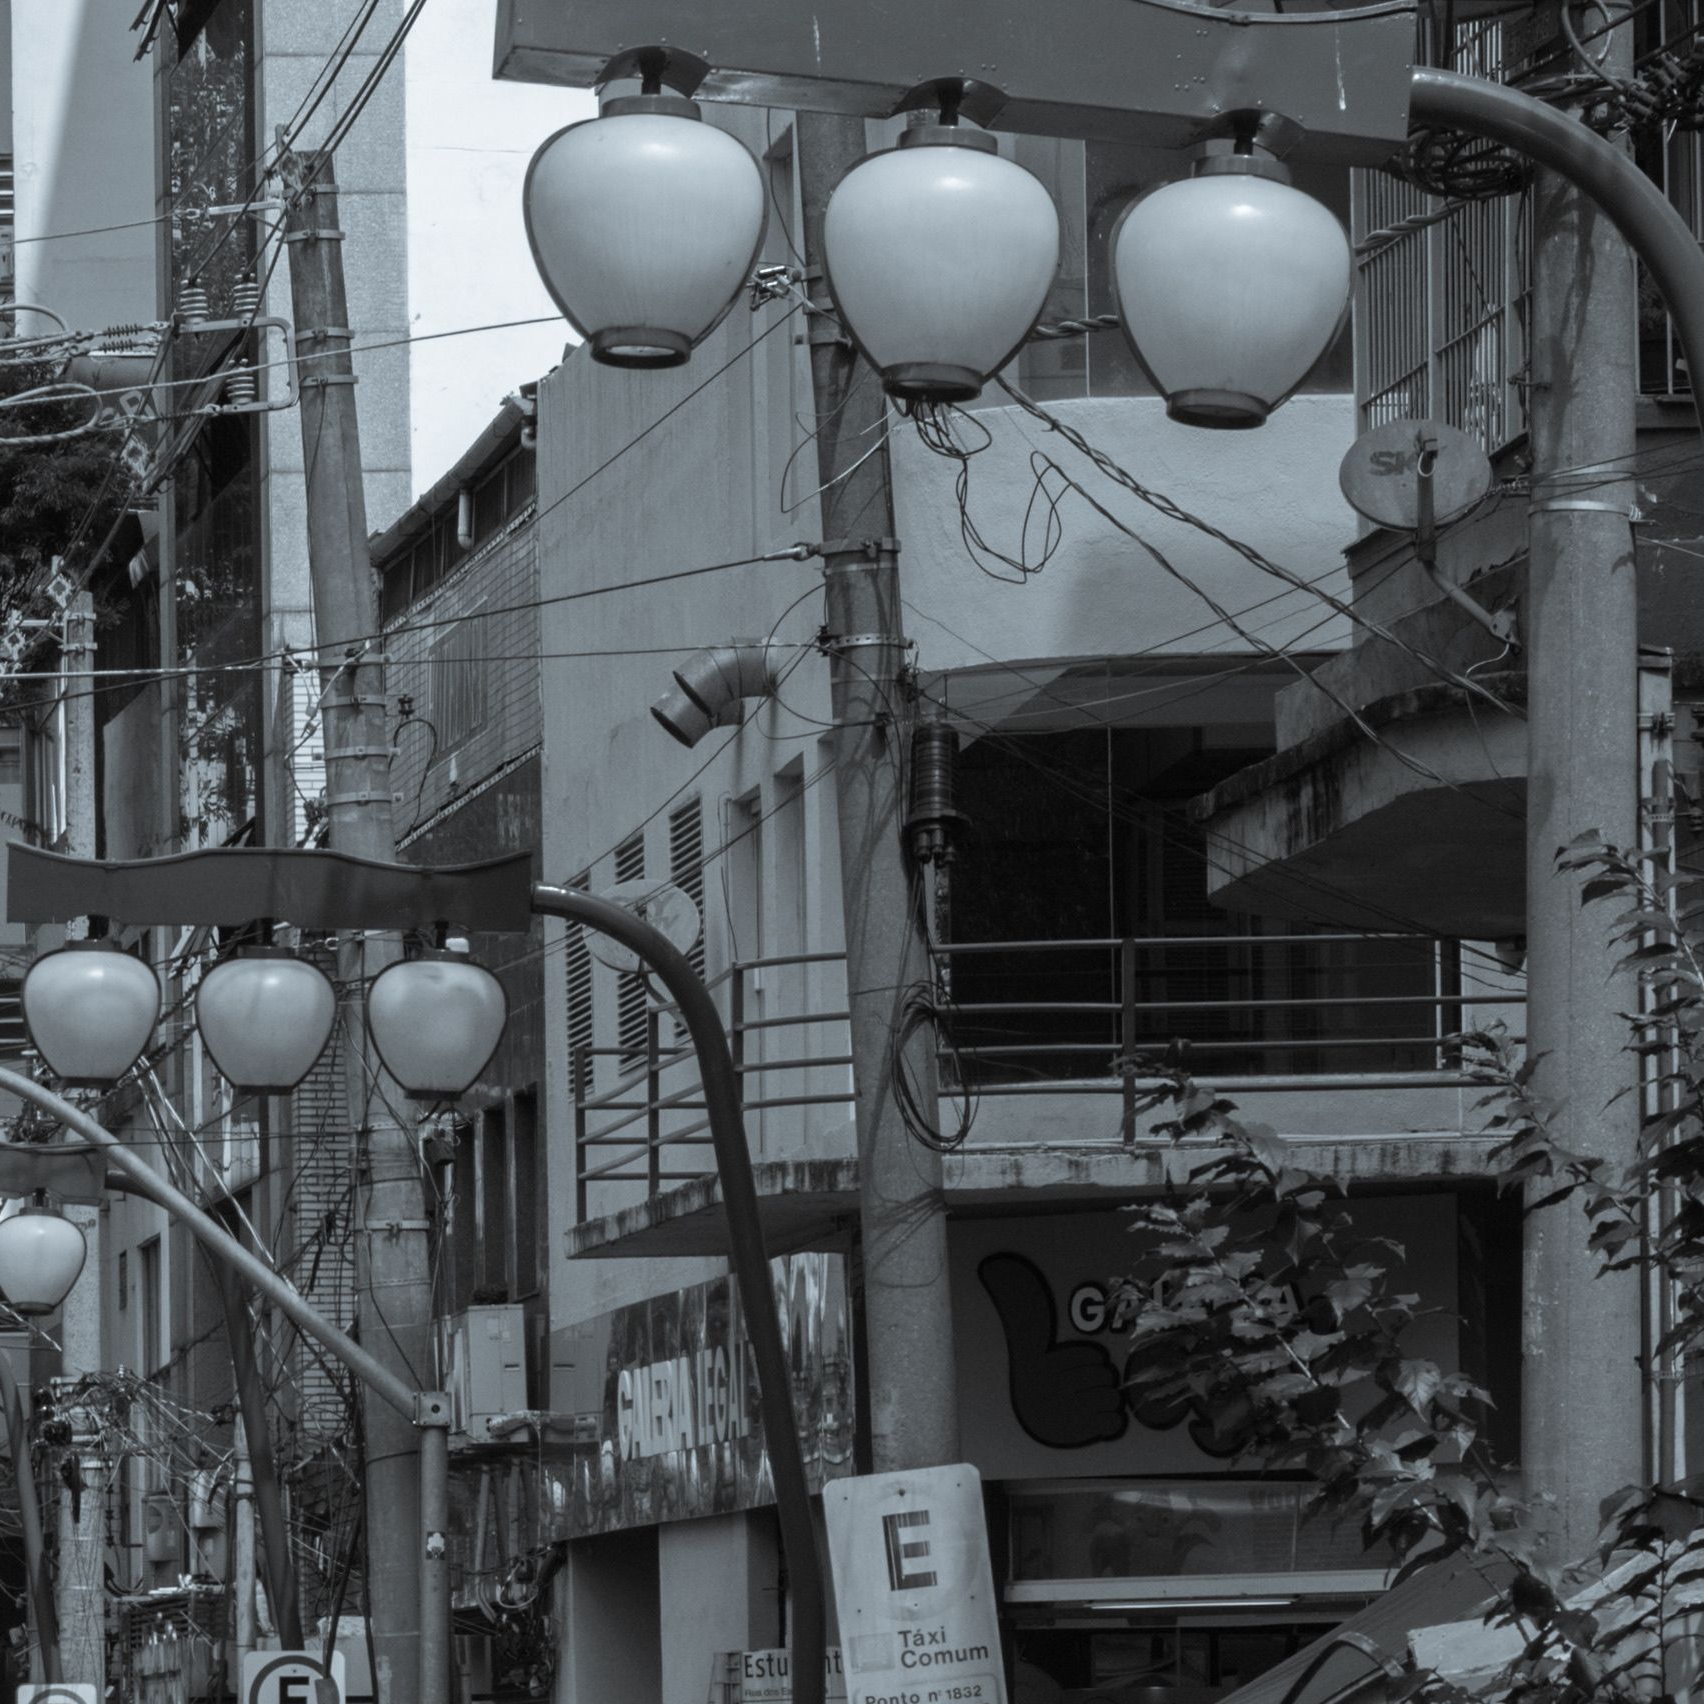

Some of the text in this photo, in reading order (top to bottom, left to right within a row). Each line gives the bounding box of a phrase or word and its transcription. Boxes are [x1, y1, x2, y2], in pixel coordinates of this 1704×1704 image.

[617, 1339, 750, 1462] GALERIA LEGAL
[882, 1510, 937, 1591] E
[897, 1626, 947, 1648] Táxi
[901, 1645, 990, 1669] Comum
[945, 1684, 983, 1701] 1832
